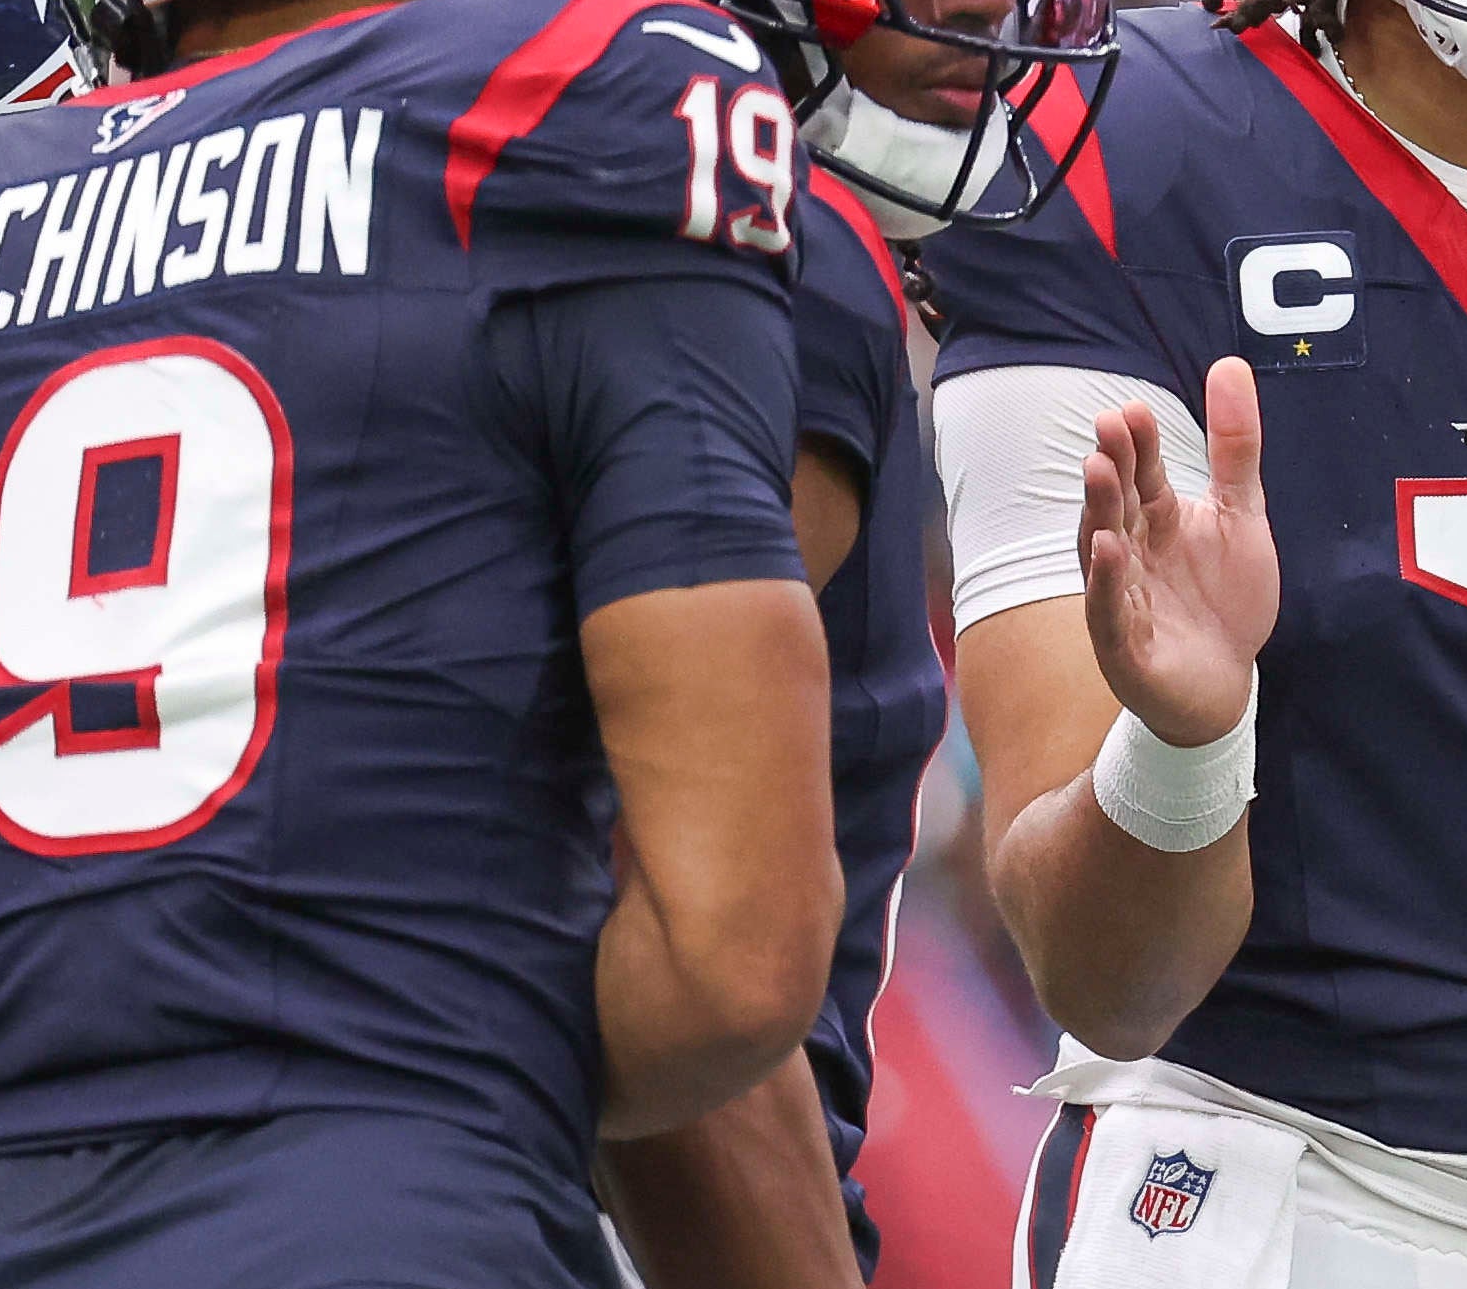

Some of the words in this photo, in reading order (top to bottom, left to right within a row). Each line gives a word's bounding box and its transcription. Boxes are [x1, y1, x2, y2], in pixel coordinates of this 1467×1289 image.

[672, 73, 799, 257] 19
[1239, 241, 1356, 336] C
[1136, 1183, 1191, 1229] NFL
